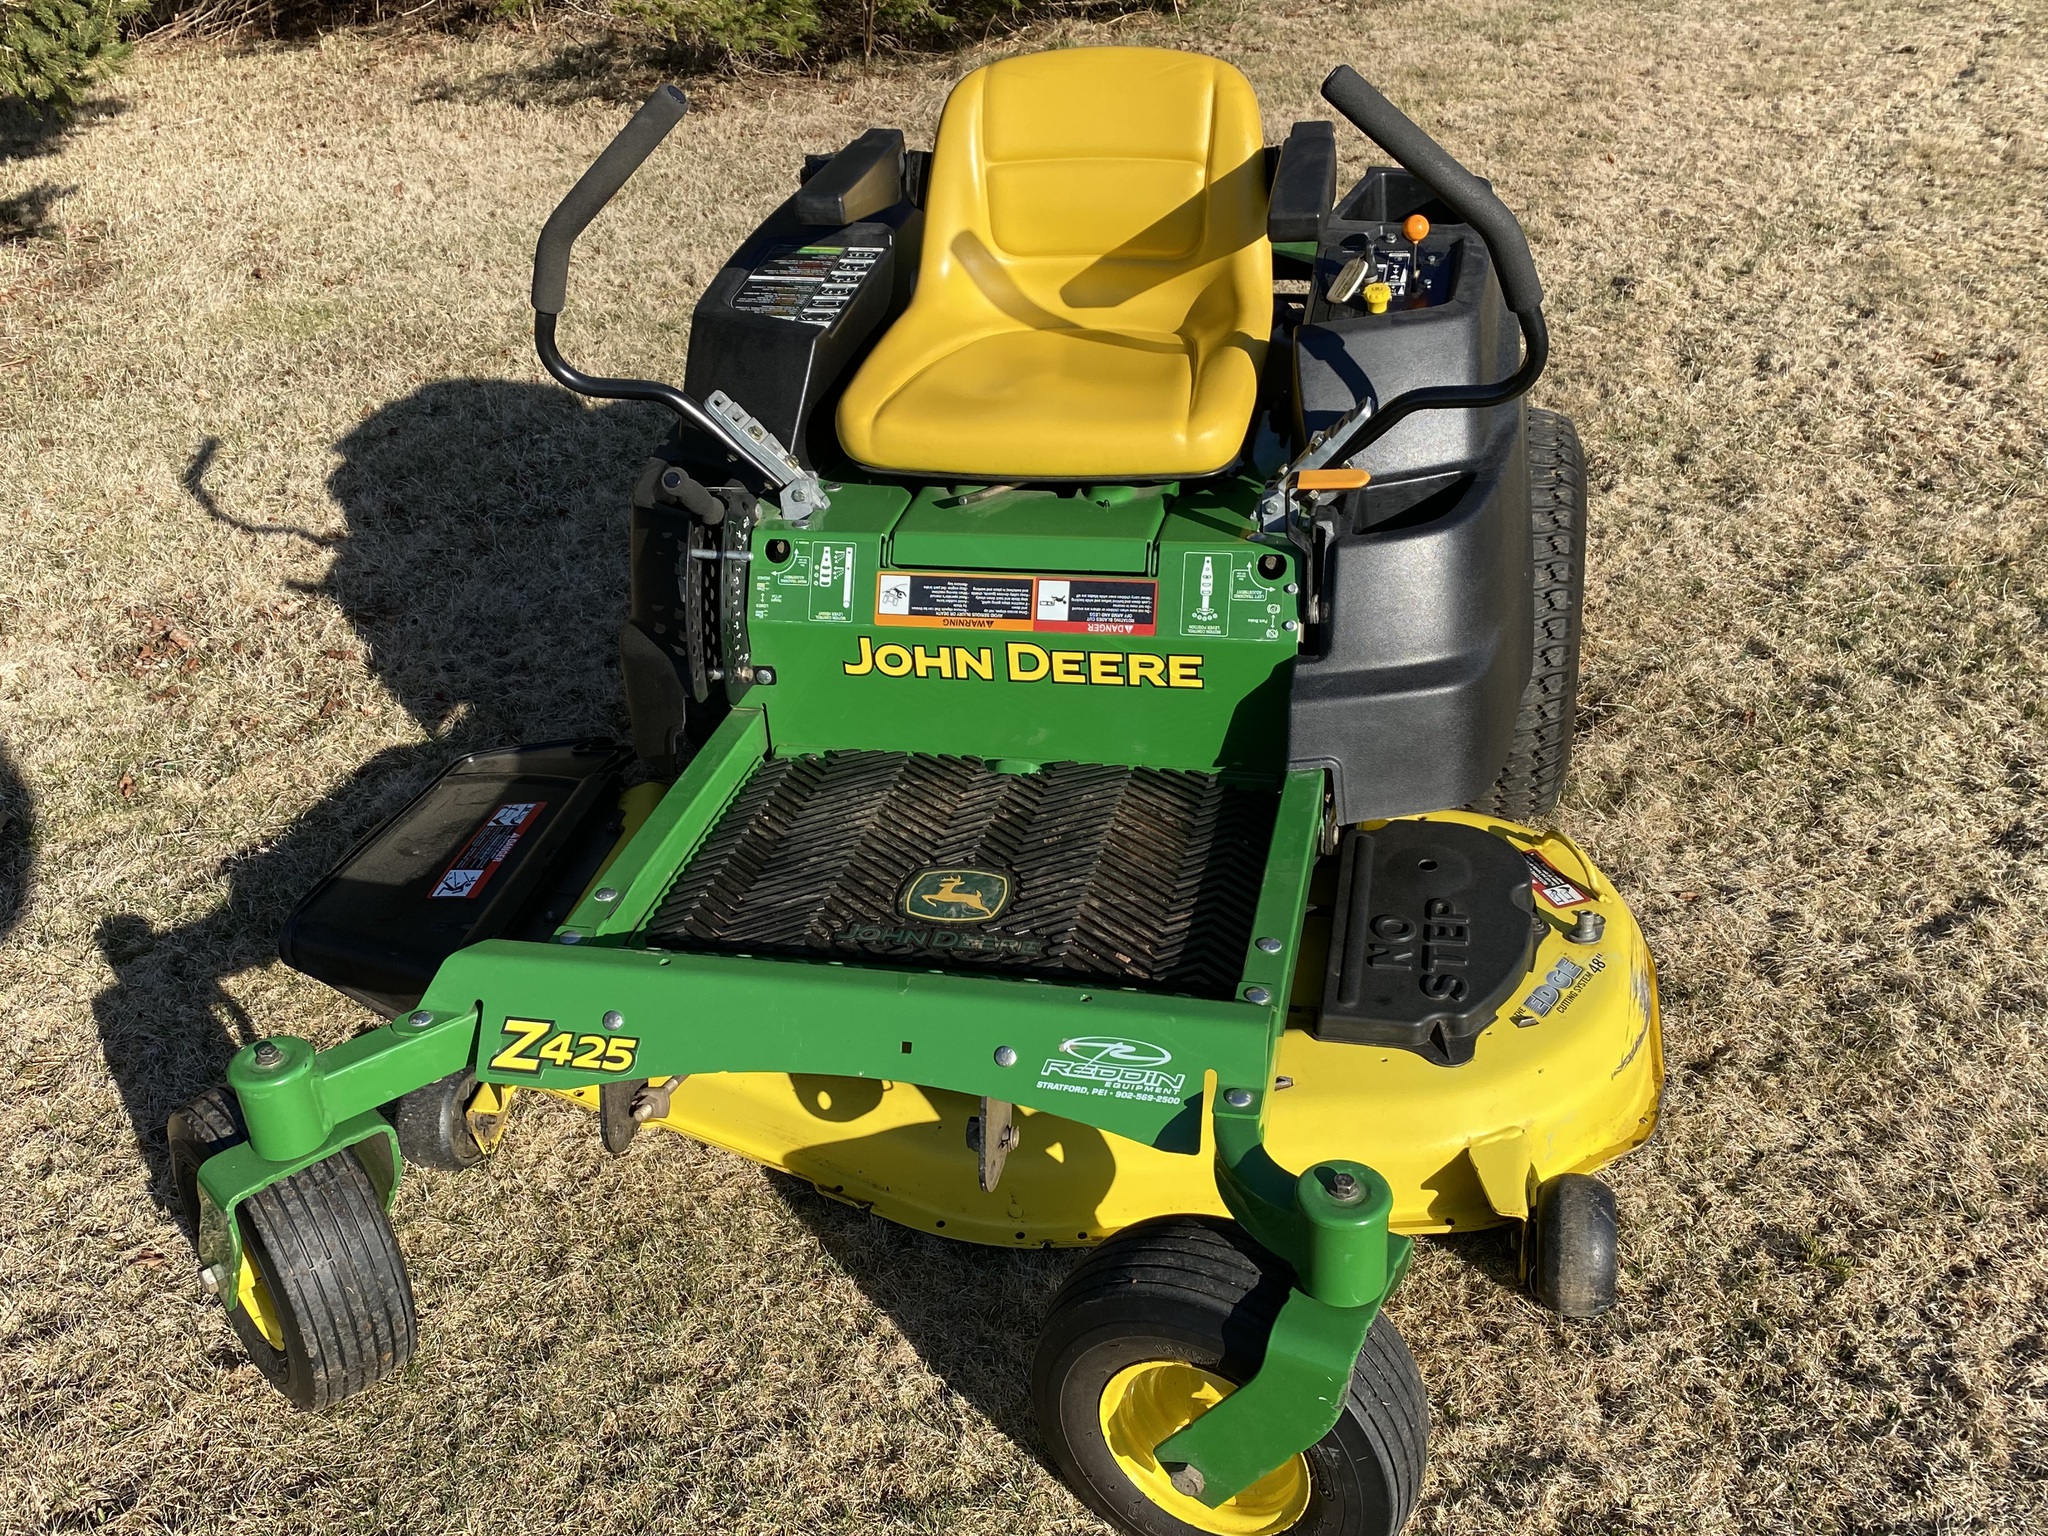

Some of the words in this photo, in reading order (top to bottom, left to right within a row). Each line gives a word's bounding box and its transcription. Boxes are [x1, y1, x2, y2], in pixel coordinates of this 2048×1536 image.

[942, 618, 986, 627] WARNING
[1088, 624, 1123, 632] DANGER
[843, 636, 994, 681] JOHN
[1006, 642, 1204, 689] DEERE
[834, 924, 929, 946] JOHN
[932, 930, 1042, 954] DEERE
[1368, 913, 1416, 970] NO
[1420, 898, 1470, 1002] STEP
[1524, 957, 1584, 1018] EDGE
[1556, 990, 1578, 1014] CUTTING
[1576, 972, 1594, 993] SYSTEM
[488, 1016, 639, 1074] Z425
[1036, 1080, 1090, 1094] STRATFORD,
[1091, 1088, 1108, 1096] PEI
[1115, 1090, 1180, 1105] 902-569-2500
[1104, 1082, 1181, 1095] EQUIPMENT
